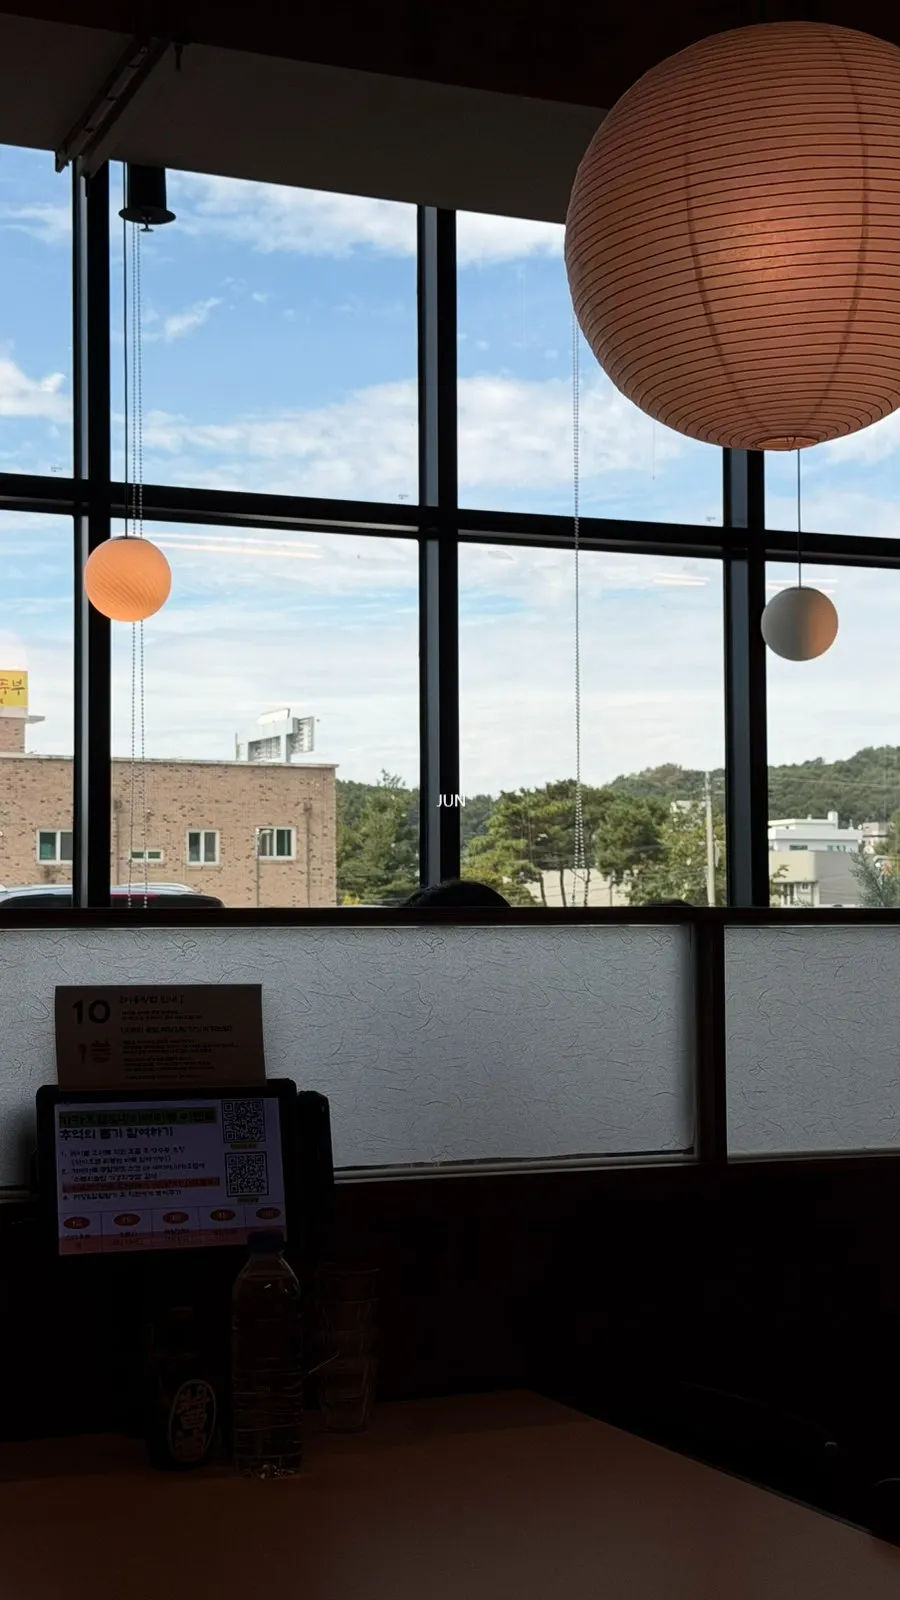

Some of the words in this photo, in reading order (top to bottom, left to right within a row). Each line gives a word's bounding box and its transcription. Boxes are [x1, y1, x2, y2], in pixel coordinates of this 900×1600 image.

[72, 999, 111, 1025] 10
[59, 1128, 96, 1141] 추억의
[127, 1126, 173, 1138] 참여하기
